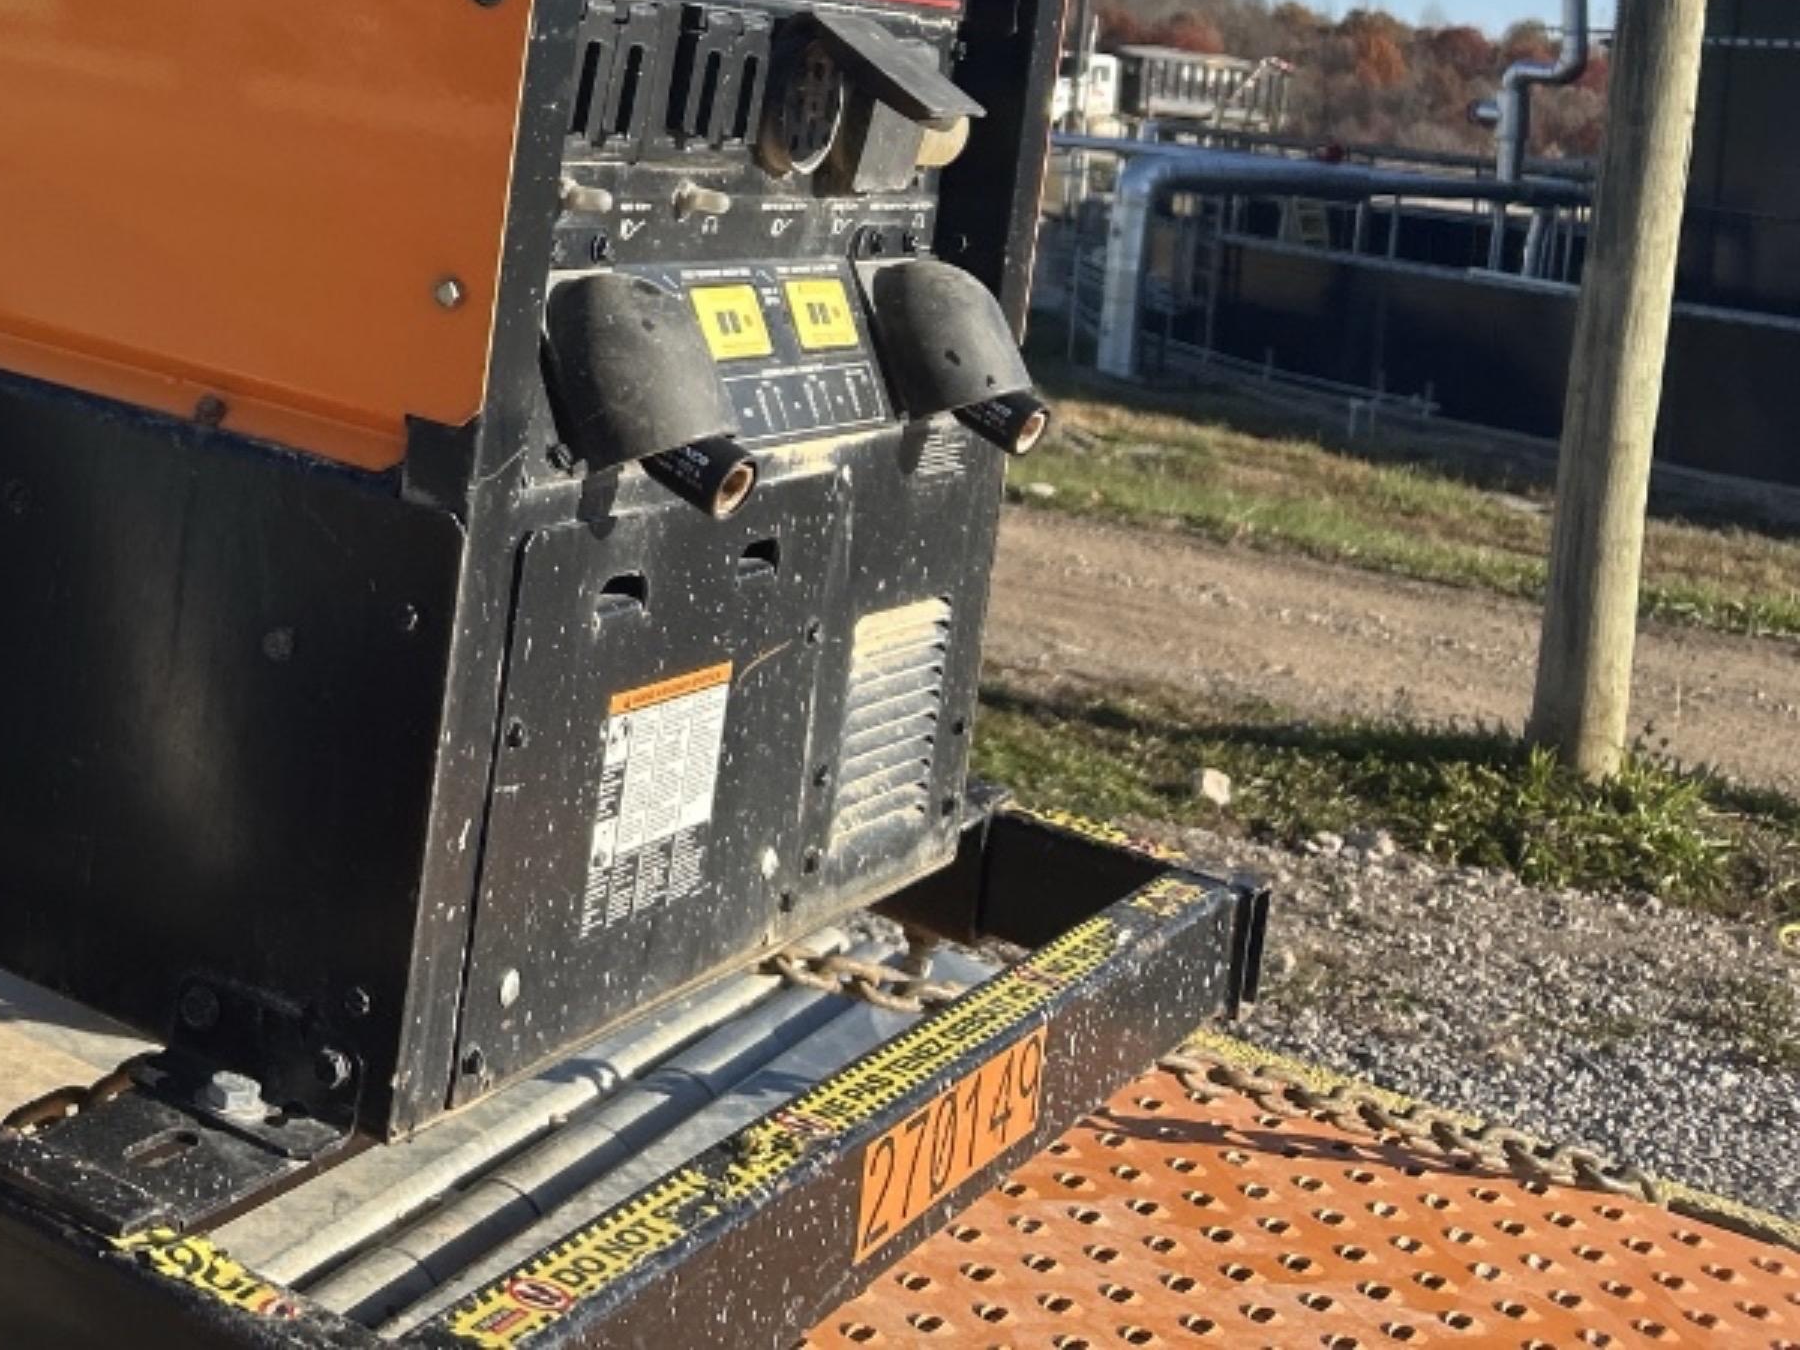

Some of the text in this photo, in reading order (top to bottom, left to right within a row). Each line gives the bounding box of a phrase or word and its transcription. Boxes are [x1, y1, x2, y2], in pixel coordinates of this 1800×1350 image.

[863, 1034, 1041, 1249] 270149
[551, 1216, 663, 1289] DO NOT
